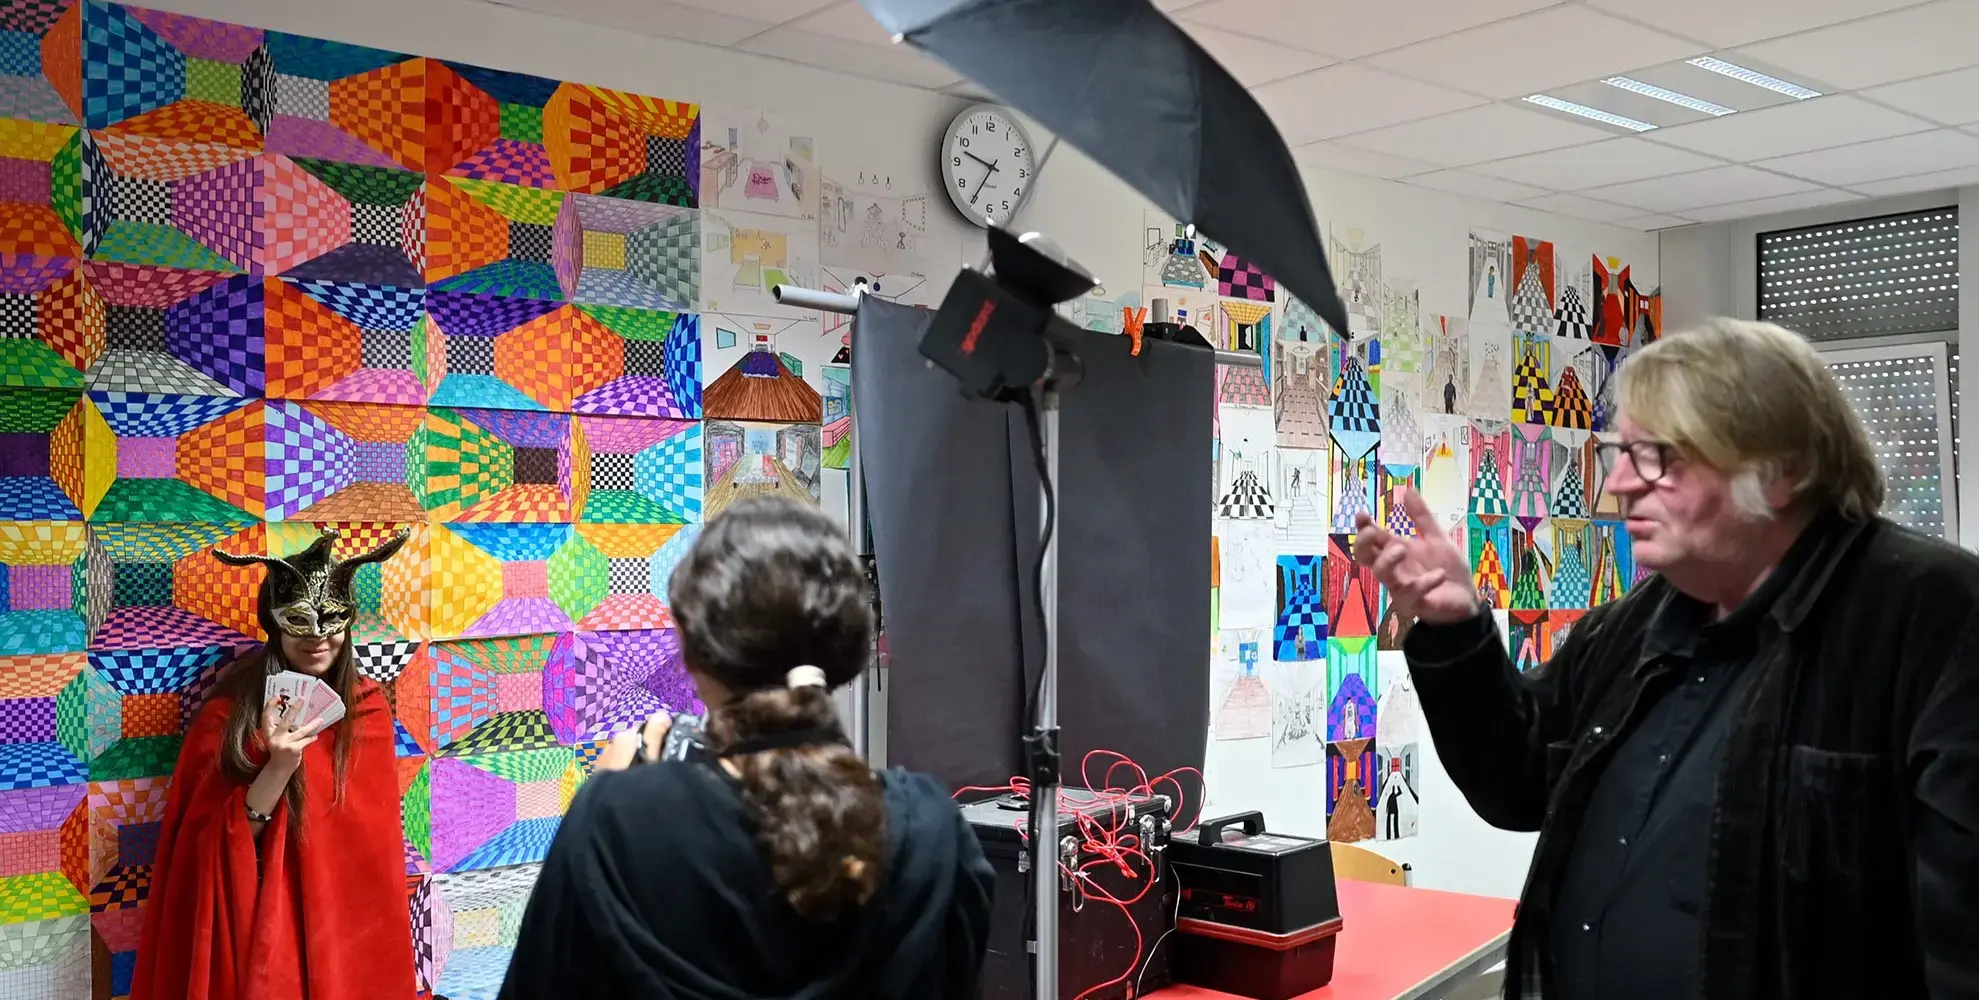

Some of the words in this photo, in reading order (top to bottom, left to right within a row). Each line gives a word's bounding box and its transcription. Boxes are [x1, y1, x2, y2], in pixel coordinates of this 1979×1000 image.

[972, 126, 978, 135] 11
[986, 122, 996, 132] 12
[960, 138, 970, 148] 10
[1014, 148, 1021, 157] 2
[953, 157, 961, 166] 9
[1019, 169, 1026, 178] 3
[958, 178, 966, 188] 8
[1014, 188, 1021, 197] 4
[986, 204, 993, 213] 6
[1002, 200, 1009, 210] 5
